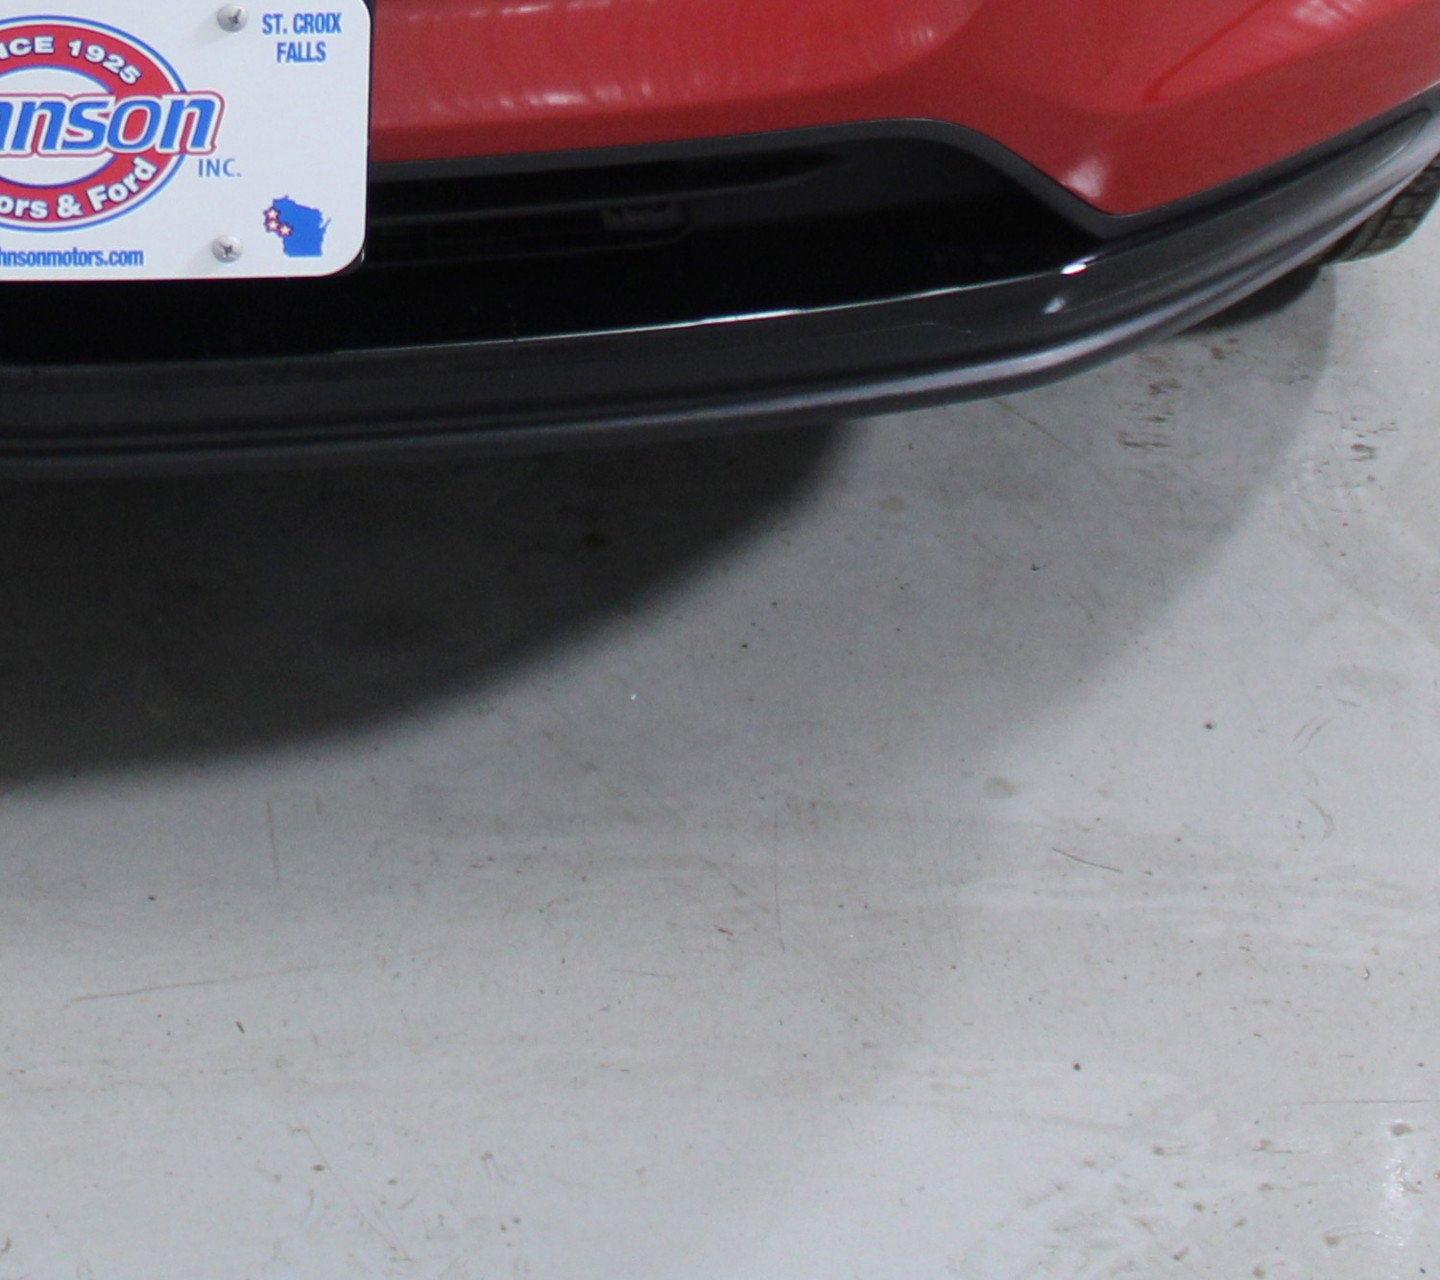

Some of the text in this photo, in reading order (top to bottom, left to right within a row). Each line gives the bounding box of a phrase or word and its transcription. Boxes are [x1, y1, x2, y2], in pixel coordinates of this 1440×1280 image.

[261, 12, 342, 35] ST. CROIX
[68, 39, 142, 85] 1925
[276, 41, 326, 63] FALLS
[197, 159, 243, 179] INC.
[57, 195, 83, 220] &
[87, 157, 157, 212] Ford
